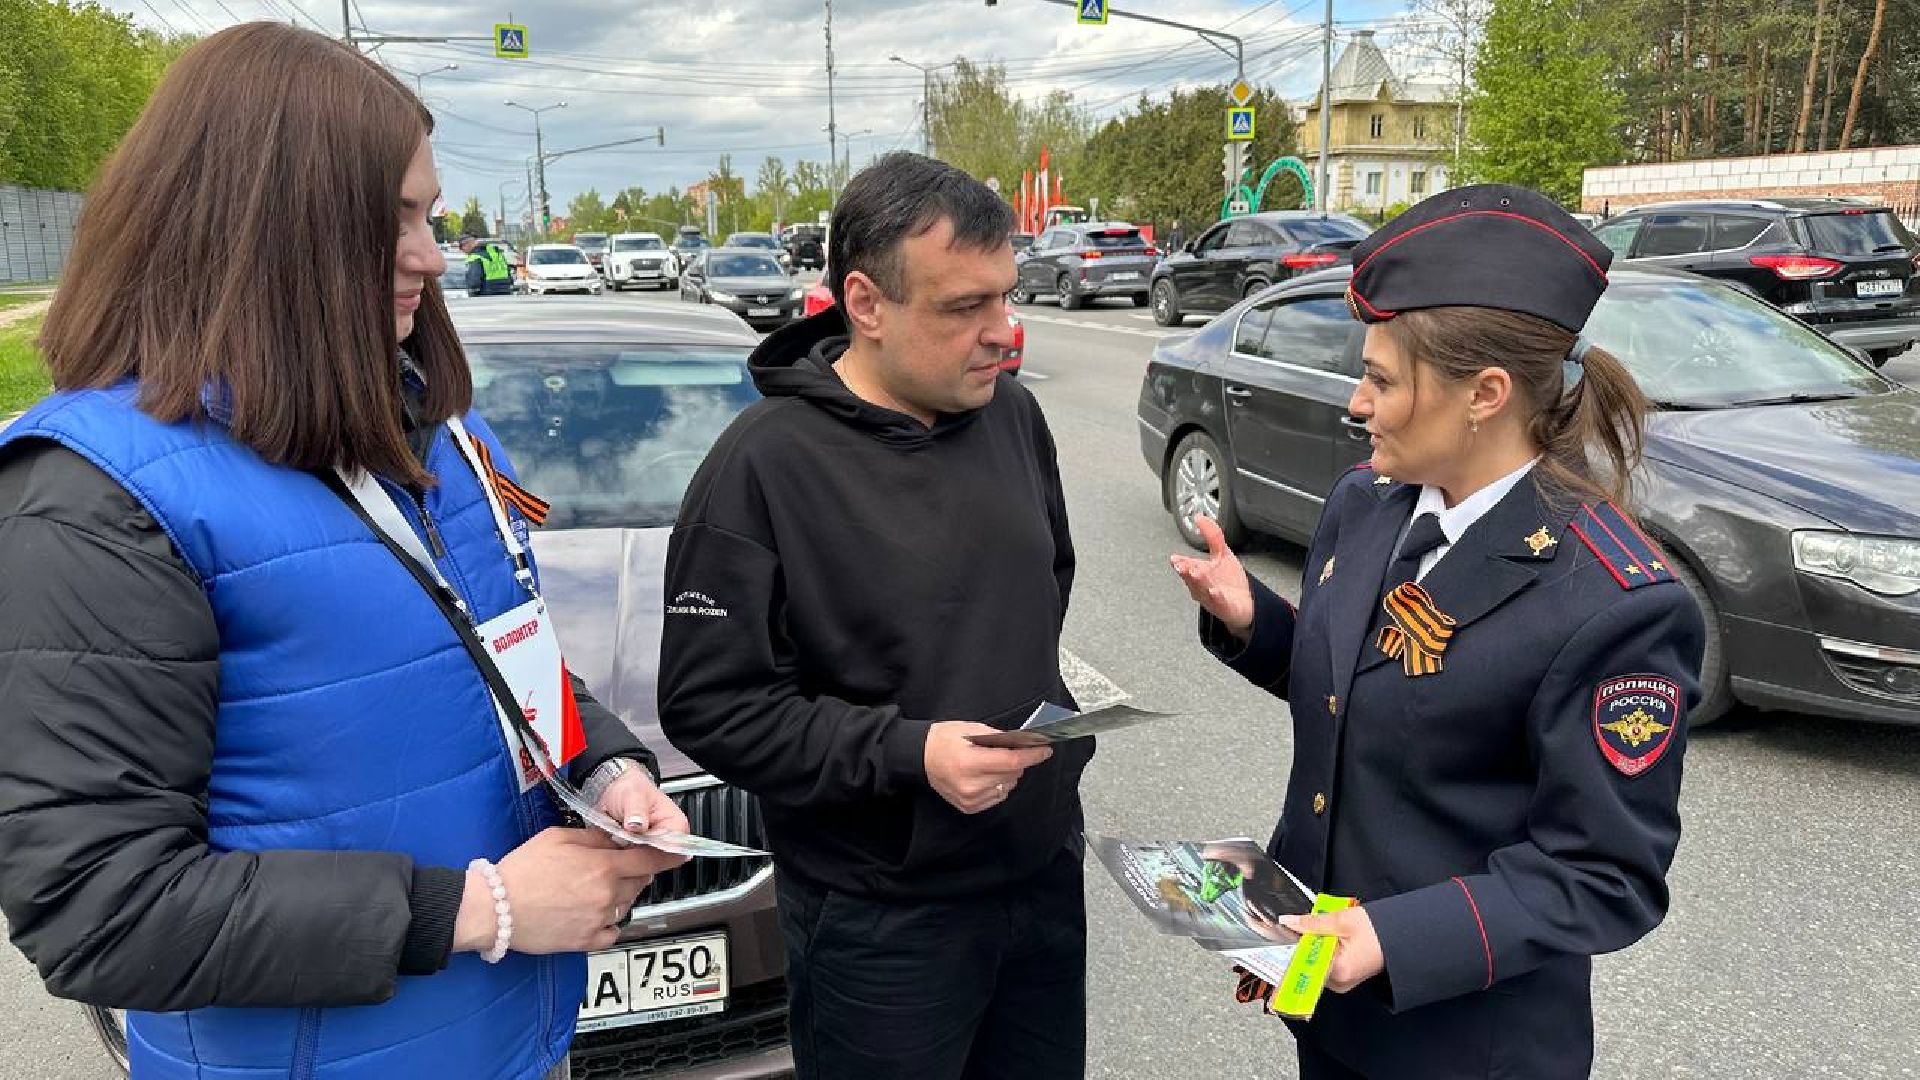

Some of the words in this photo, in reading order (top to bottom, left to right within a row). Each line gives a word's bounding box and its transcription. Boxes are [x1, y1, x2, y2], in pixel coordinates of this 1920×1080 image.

[689, 605, 698, 614] &
[493, 618, 539, 654] ВОЛОНТЕР
[1602, 680, 1676, 699] ПОЛИЦИЯ
[1609, 695, 1667, 712] РОССИЯ
[633, 945, 712, 988] 750
[583, 971, 622, 1009] А
[653, 983, 691, 1000] RUS
